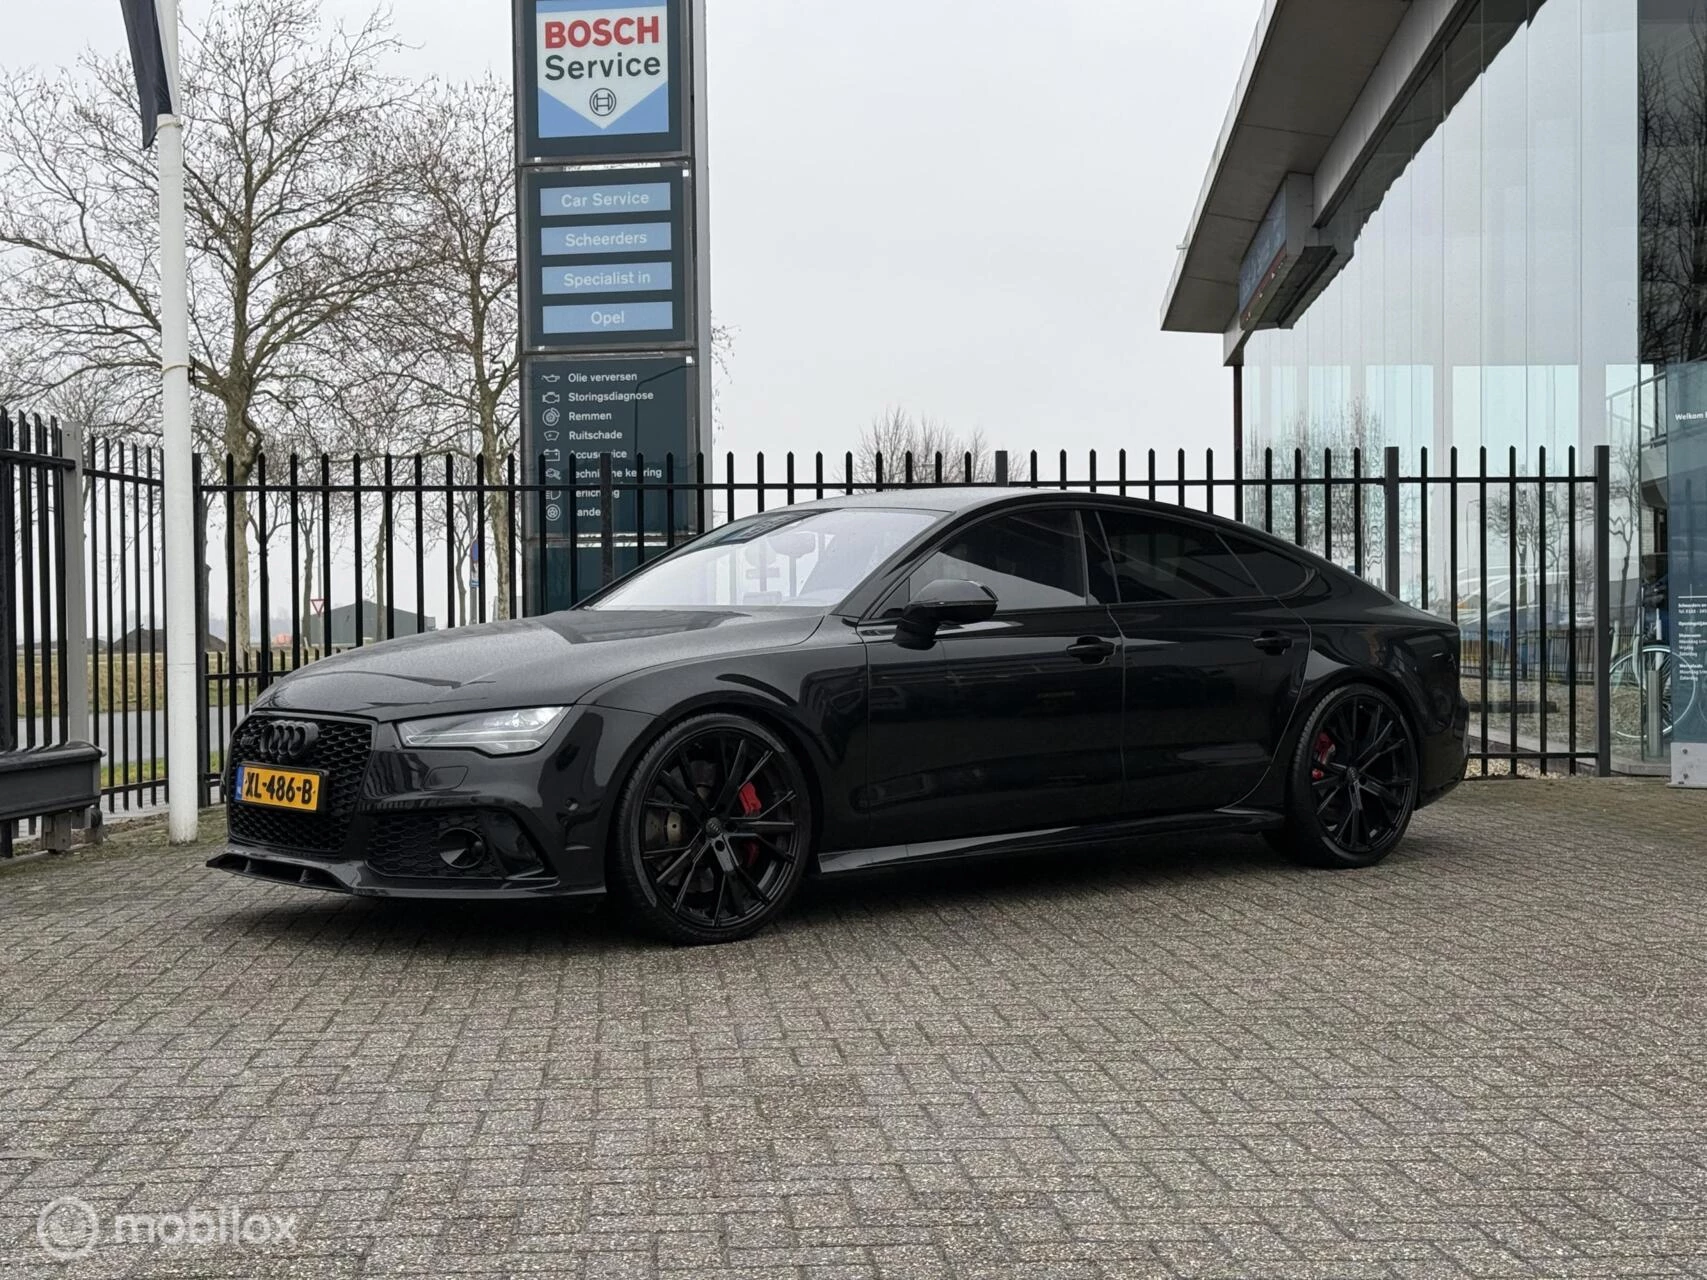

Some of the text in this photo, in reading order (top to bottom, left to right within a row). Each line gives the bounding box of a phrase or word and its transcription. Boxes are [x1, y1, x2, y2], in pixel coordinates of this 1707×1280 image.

[545, 16, 659, 49] BOSCH
[545, 52, 661, 80] Service
[561, 192, 649, 207] Car Service
[565, 232, 647, 247] Scheerders
[564, 271, 651, 288] Specialist in
[591, 311, 625, 327] Opel
[568, 373, 637, 383] Olie verversen
[568, 392, 654, 403] Storingsdiagnose
[568, 411, 612, 421] Remmen
[569, 430, 623, 441] Ruitschade
[625, 467, 662, 479] kering
[573, 507, 603, 517] ande
[245, 772, 314, 805] XL-486-B
